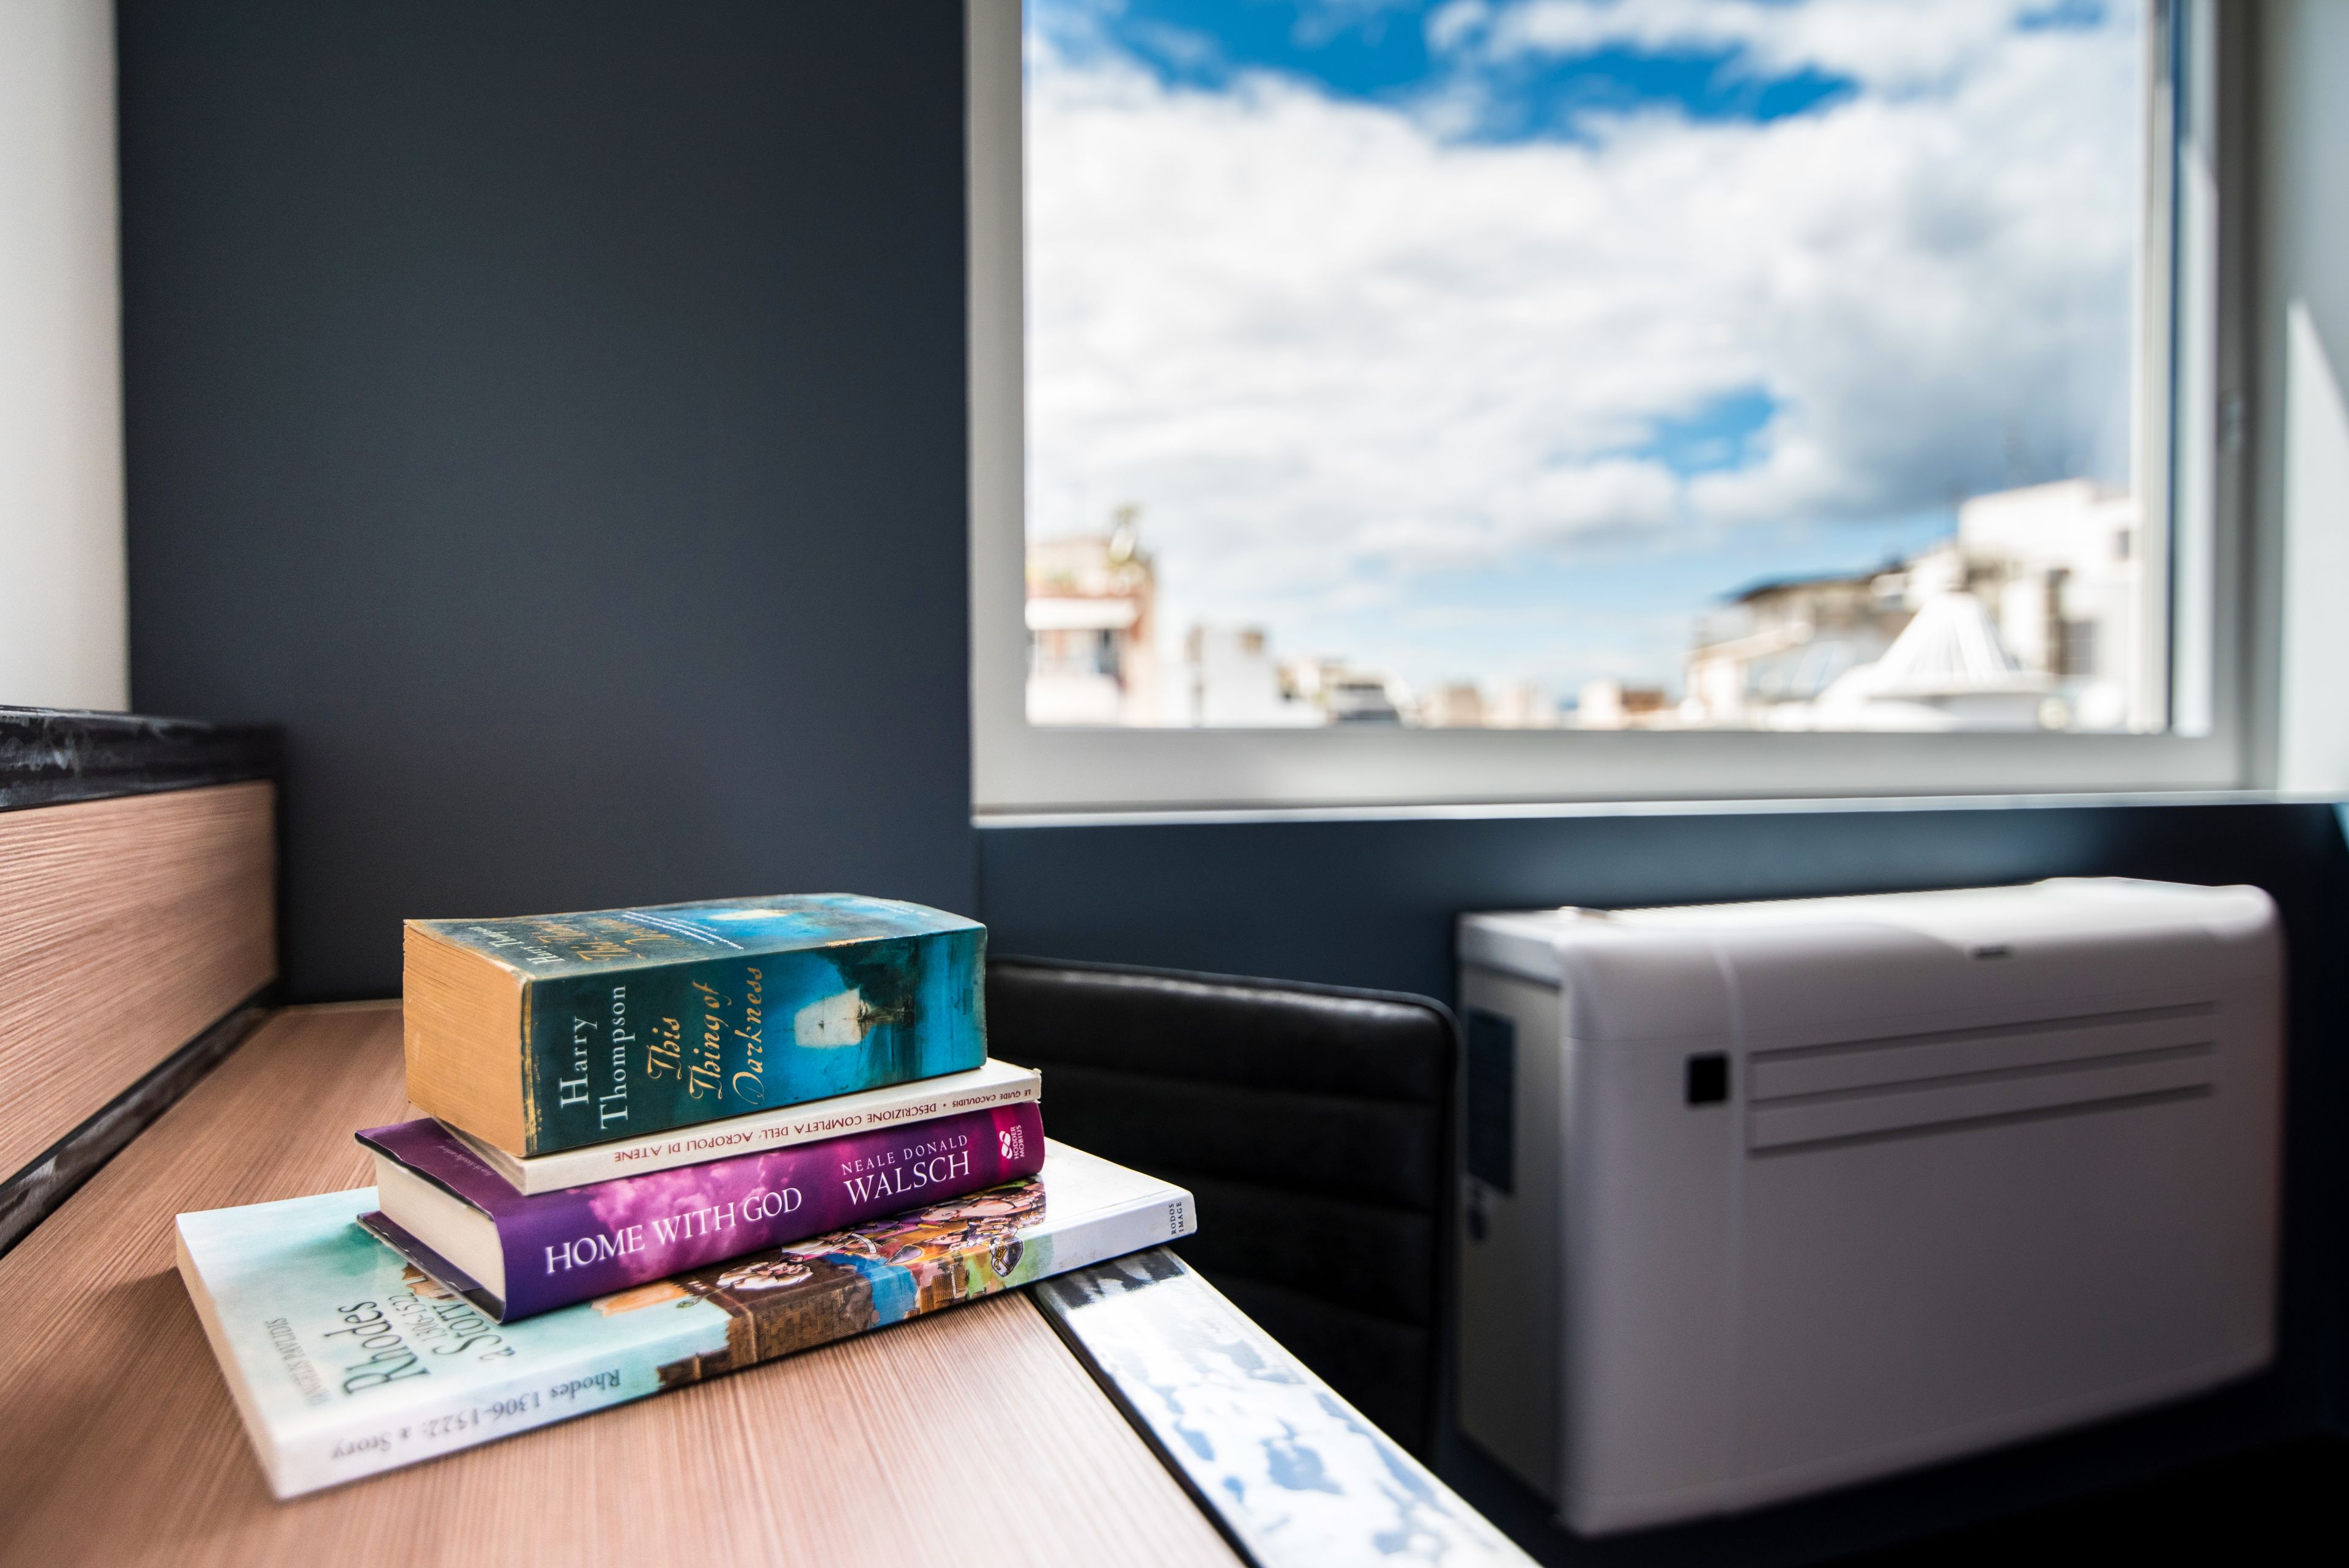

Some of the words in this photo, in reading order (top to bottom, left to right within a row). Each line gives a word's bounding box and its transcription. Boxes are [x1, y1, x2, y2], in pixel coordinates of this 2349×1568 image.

[520, 946, 565, 964] Harry
[693, 979, 732, 1008] of
[647, 1017, 681, 1080] This
[732, 967, 765, 1105] Darkness
[560, 1016, 598, 1109] Harry
[600, 985, 636, 1129] Thompson
[688, 1014, 732, 1100] Thing
[952, 1094, 996, 1107] CACOULIDIS
[1000, 1090, 1021, 1100] GUIDE
[795, 1117, 863, 1134] COMPLETA
[867, 1103, 937, 1123] DESCRIZIONE
[614, 1145, 662, 1162] ATENE
[669, 1143, 680, 1154] DI
[687, 1131, 753, 1151] ACROPOLI
[841, 1152, 896, 1175] NEALE
[904, 1135, 968, 1160] DONALD
[1011, 1126, 1019, 1159] HODDER
[1016, 1125, 1025, 1157] MOBIUS
[844, 1151, 970, 1205] WALSCH
[545, 1224, 645, 1274] HOME
[652, 1202, 737, 1246] WITH
[743, 1187, 802, 1221] GOD
[388, 1291, 448, 1341] 1306-1522
[432, 1302, 503, 1355] Story
[264, 1318, 306, 1361] PAVLIDIS
[324, 1301, 431, 1395] Rhodes
[479, 1345, 516, 1361] a
[551, 1369, 621, 1400] Rhodes
[332, 1432, 392, 1459] Story
[399, 1428, 412, 1439] a
